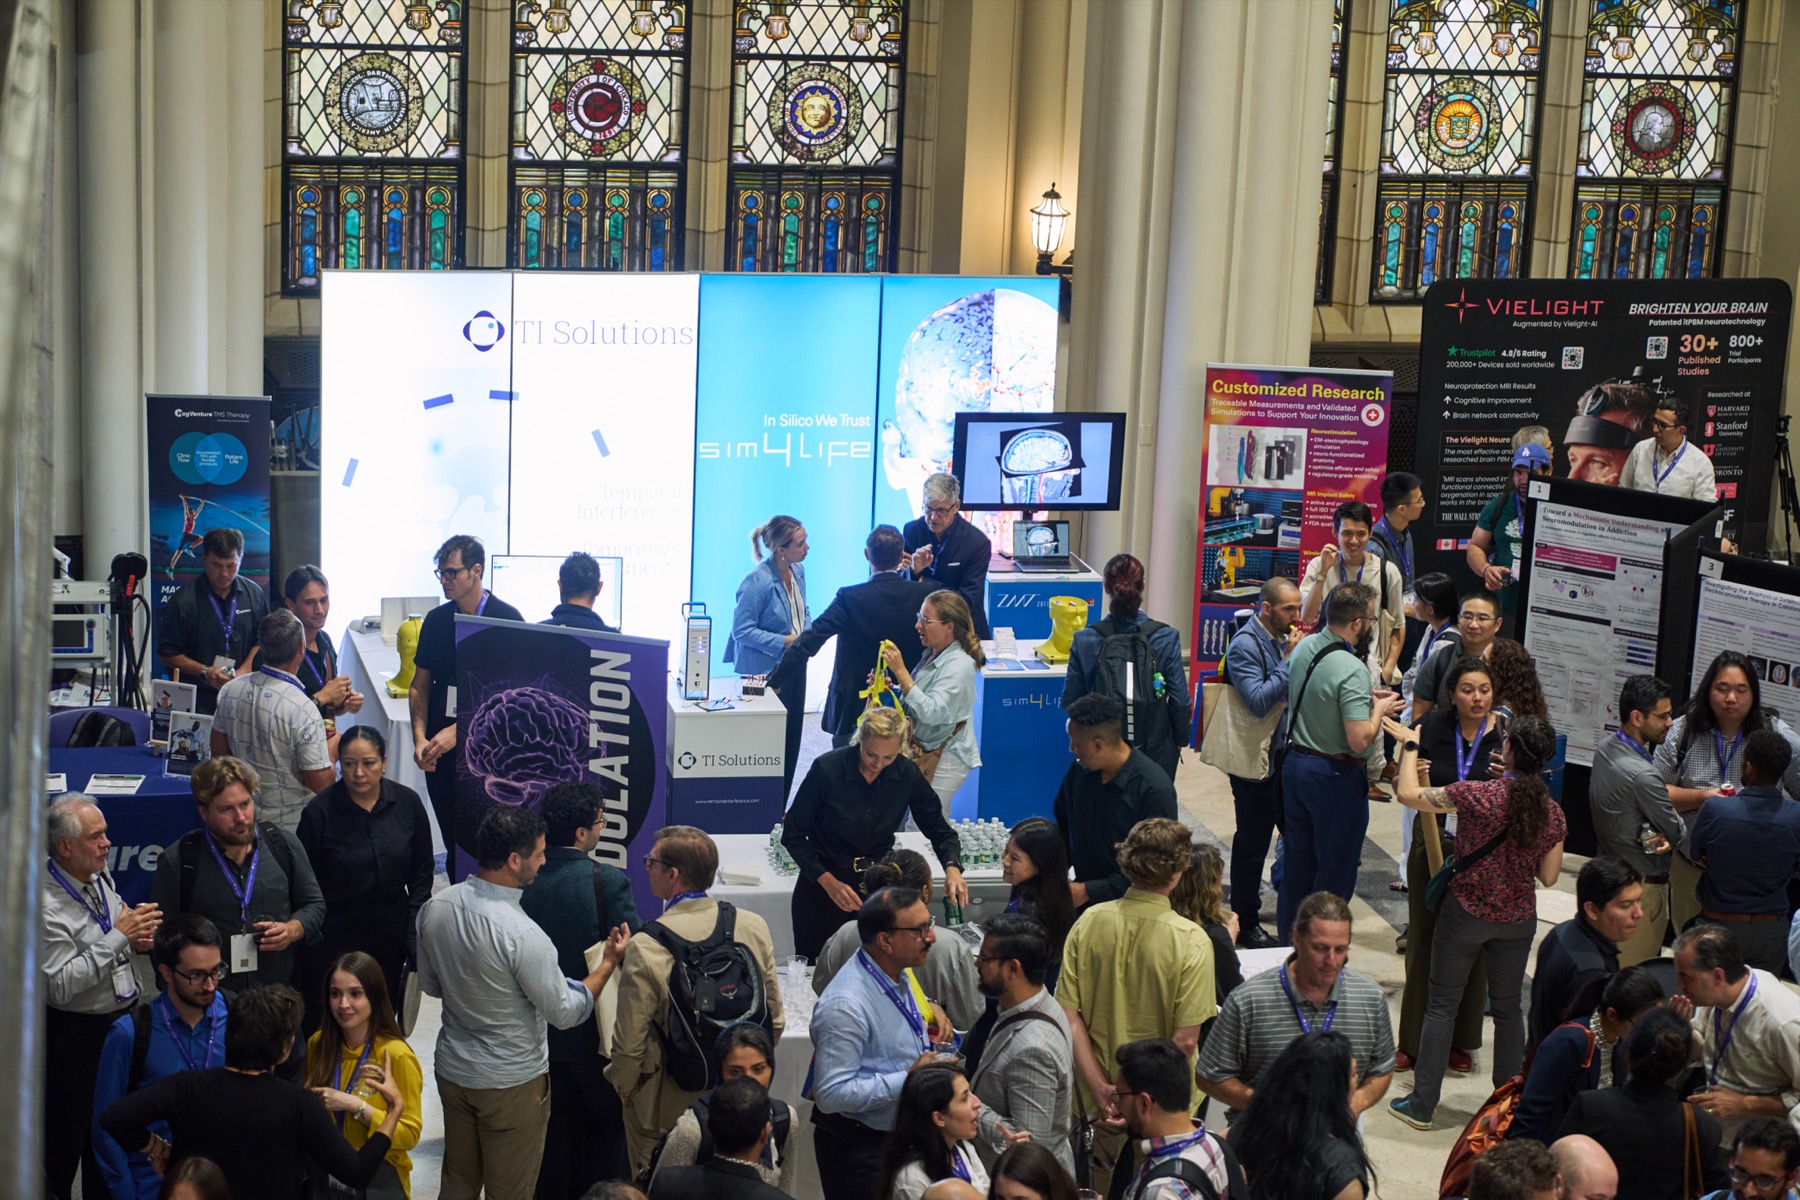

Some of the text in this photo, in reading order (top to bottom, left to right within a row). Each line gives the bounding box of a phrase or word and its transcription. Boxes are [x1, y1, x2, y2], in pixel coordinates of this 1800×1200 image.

[567, 76, 629, 116] UNIVERSITY OF CHICAGO
[827, 84, 846, 110] BOWDOIN
[351, 121, 381, 135] AMERICA
[1487, 298, 1604, 315] VIELIGHT
[1629, 302, 1768, 315] BRIGHTEN YOUR BRAIN
[1513, 321, 1552, 329] Augmented
[1563, 320, 1597, 328] Vielight-AI
[1705, 318, 1766, 327] neurotechnology
[515, 320, 694, 345] TI Solutions
[1680, 334, 1719, 353] 30+
[1729, 335, 1764, 348] 800+
[1460, 349, 1547, 359] Trustpilot 4.8/5 Rating
[1678, 356, 1721, 364] Published
[1446, 361, 1476, 369] 200,000+
[1677, 368, 1710, 376] Studies
[1212, 379, 1385, 400] Customized Research
[1445, 383, 1498, 391] Neuroprotection
[1212, 399, 1357, 412] Traceable Measurements and Validated
[1454, 397, 1532, 406] Cognitive Improvement
[764, 414, 871, 427] In Silico We Trust
[1211, 408, 1256, 417] Simulations
[1267, 411, 1298, 419] Support
[1300, 412, 1317, 420] Your
[1319, 413, 1359, 422] Innovation
[1499, 412, 1539, 420] connectivity
[1311, 428, 1357, 436] Neurostimulation
[1716, 421, 1748, 430] Stanford
[1314, 437, 1369, 446] EM-electrophysiology
[1460, 436, 1488, 445] Vielight
[1314, 451, 1365, 459] neuro-functionalized
[1312, 471, 1353, 479] regulatory-grade
[1715, 469, 1743, 477] ORONTO
[600, 484, 681, 503] Temporal
[577, 503, 681, 519] Interference
[1442, 513, 1467, 521] THE WALL
[1542, 516, 1597, 530] Neuromodulation
[1606, 526, 1638, 537] Addiction
[1543, 507, 1566, 517] Toward
[1573, 512, 1611, 524] Mechanistic
[1612, 519, 1660, 533] Understanding
[1709, 563, 1714, 571] 3
[1705, 587, 1749, 601] Electroconvulsive
[1750, 597, 1771, 607] Therapy
[1706, 581, 1738, 593] Investigating
[1748, 590, 1778, 601] Biophysical
[588, 649, 632, 869] DULATION
[702, 754, 781, 767] TI Solutions
